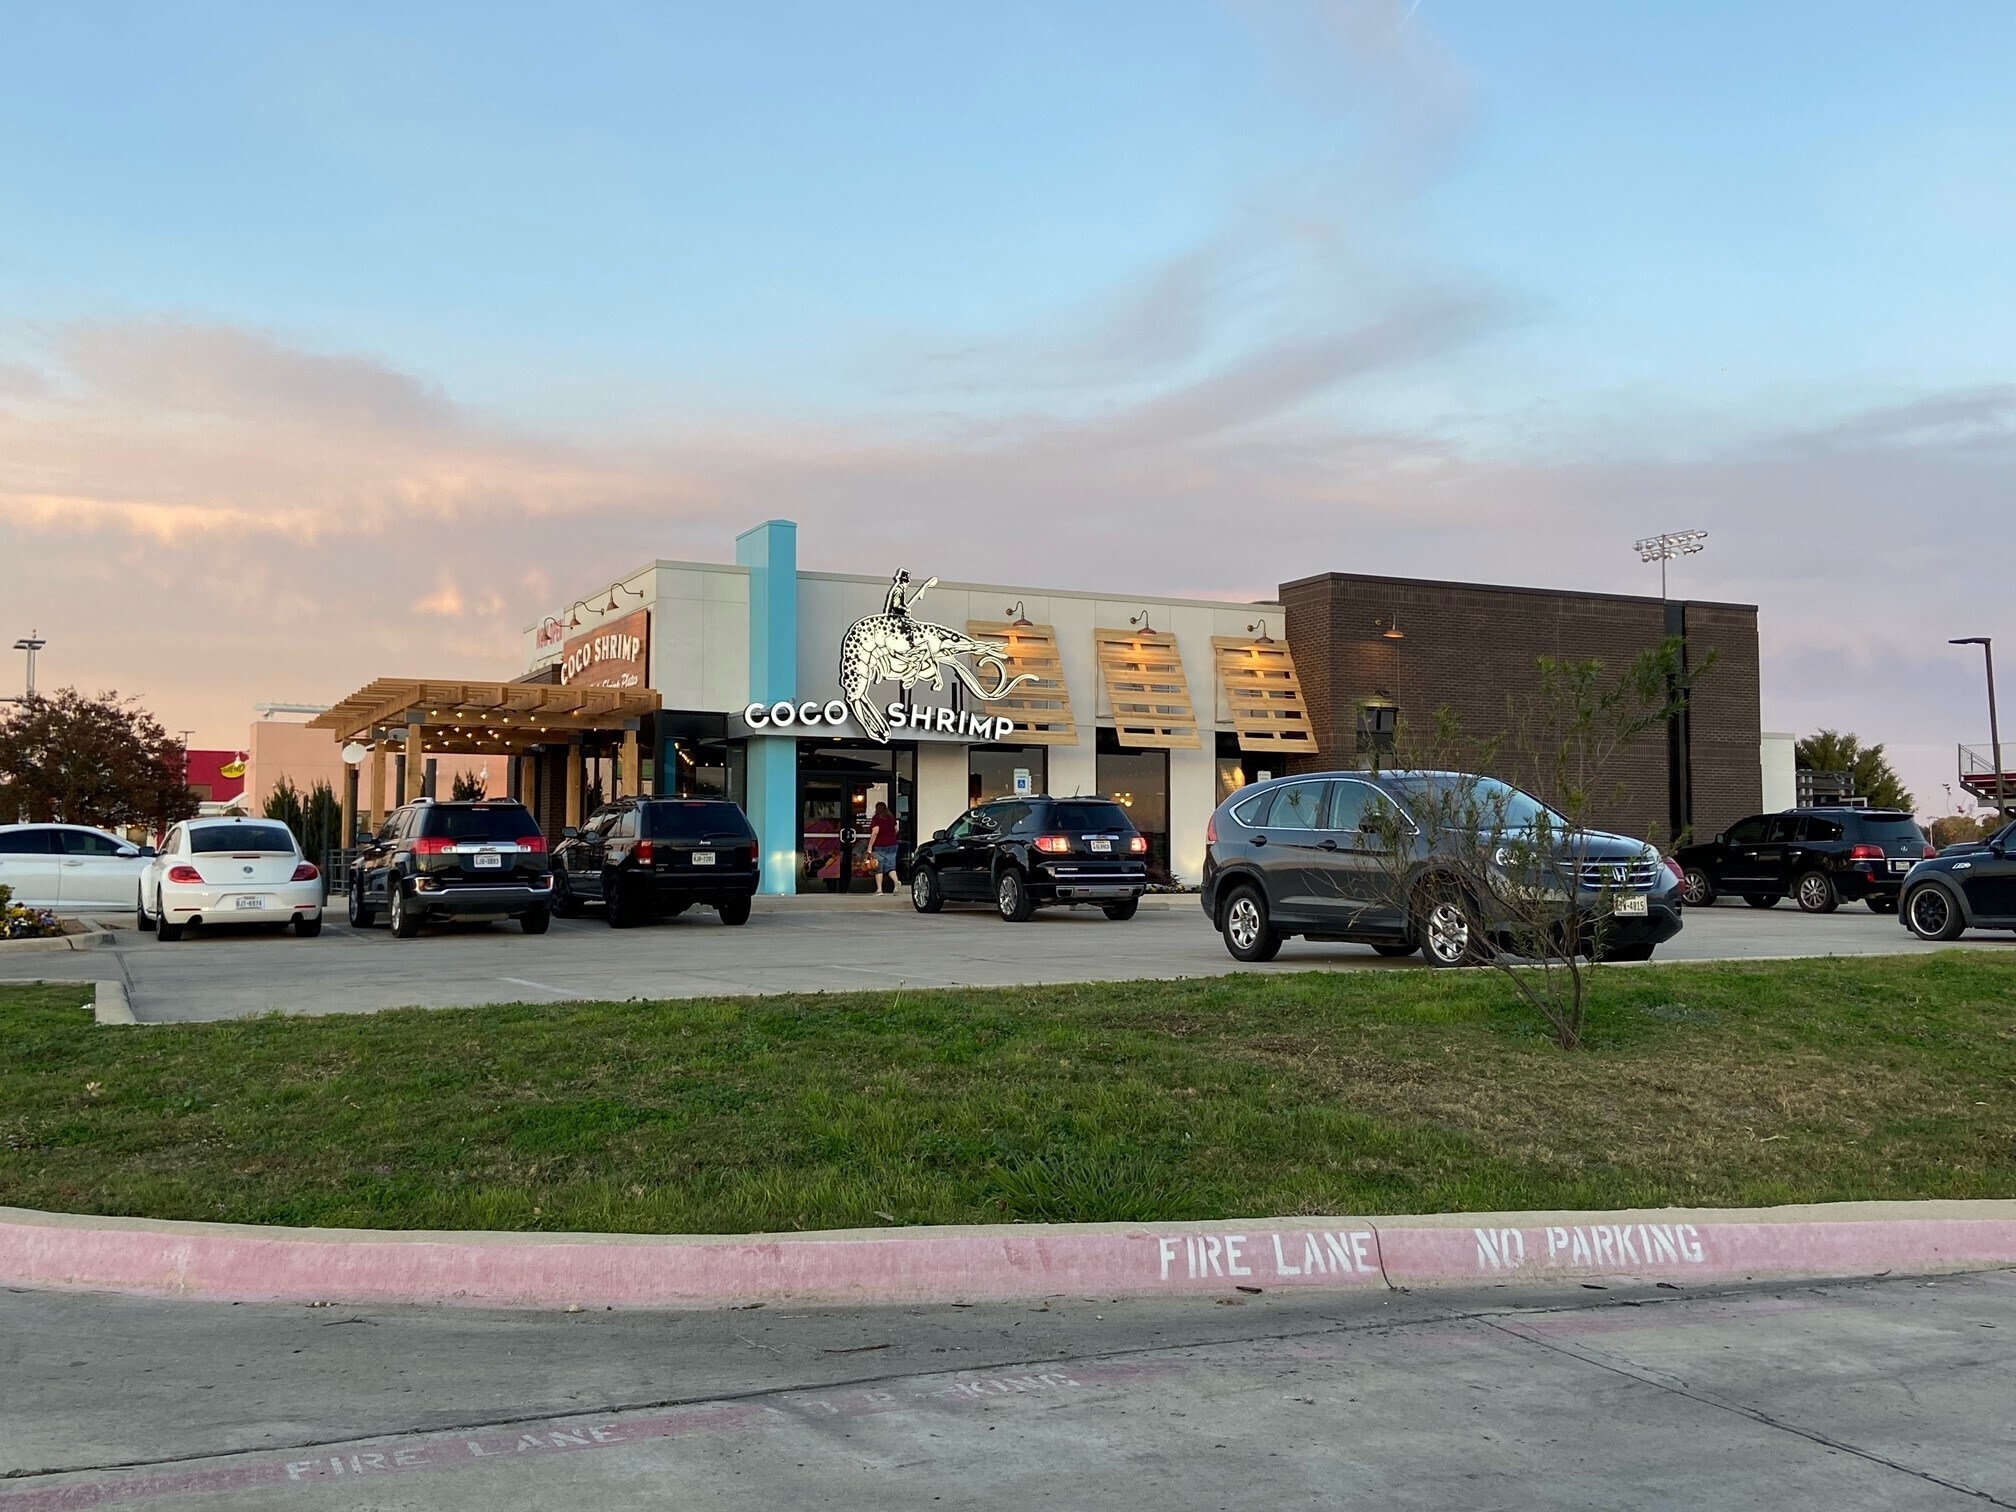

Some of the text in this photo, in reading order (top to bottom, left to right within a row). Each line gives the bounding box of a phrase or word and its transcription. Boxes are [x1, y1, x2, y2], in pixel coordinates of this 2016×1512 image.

[561, 643, 591, 685] COCO
[594, 634, 640, 662] SHRIMP
[744, 700, 1014, 740] COCO SHRIMP
[1158, 1232, 1378, 1280] FIRE LANE
[1474, 1224, 1704, 1269] NO PARKING
[286, 1423, 626, 1480] FIRE LANE
